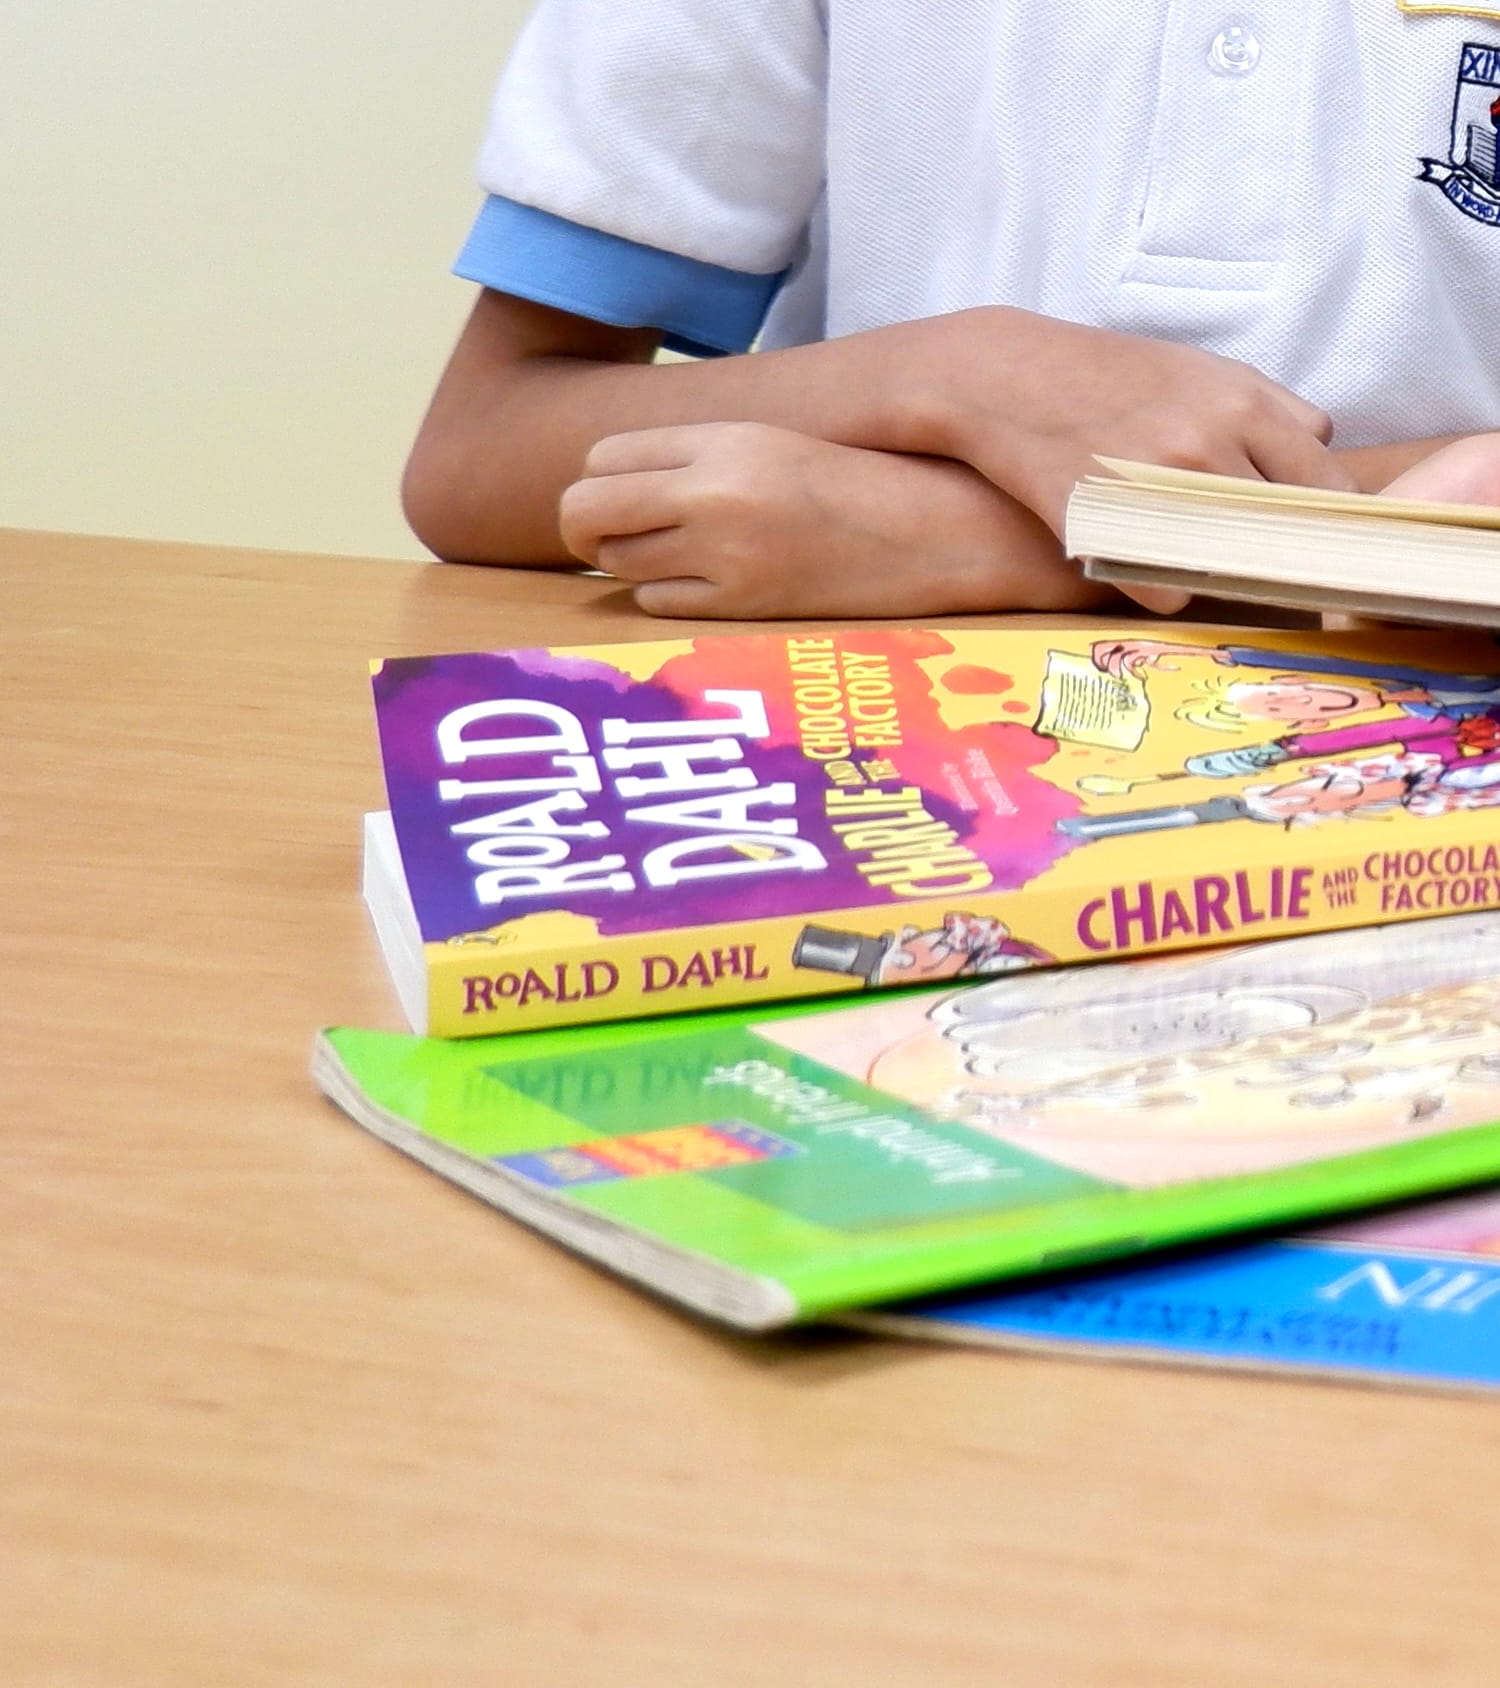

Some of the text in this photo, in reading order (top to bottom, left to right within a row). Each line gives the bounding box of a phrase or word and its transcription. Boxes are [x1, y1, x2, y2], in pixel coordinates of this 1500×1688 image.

[787, 638, 852, 760] CHOCOLATE
[841, 651, 903, 748] FACTORY
[436, 698, 637, 906] ROALD
[602, 687, 829, 888] DAHL
[826, 786, 994, 897] CHARLIE
[1077, 865, 1314, 951] CHARLIE
[1322, 868, 1359, 891] AND
[1326, 887, 1358, 910] THE
[462, 944, 771, 1015] ROALD DAHL
